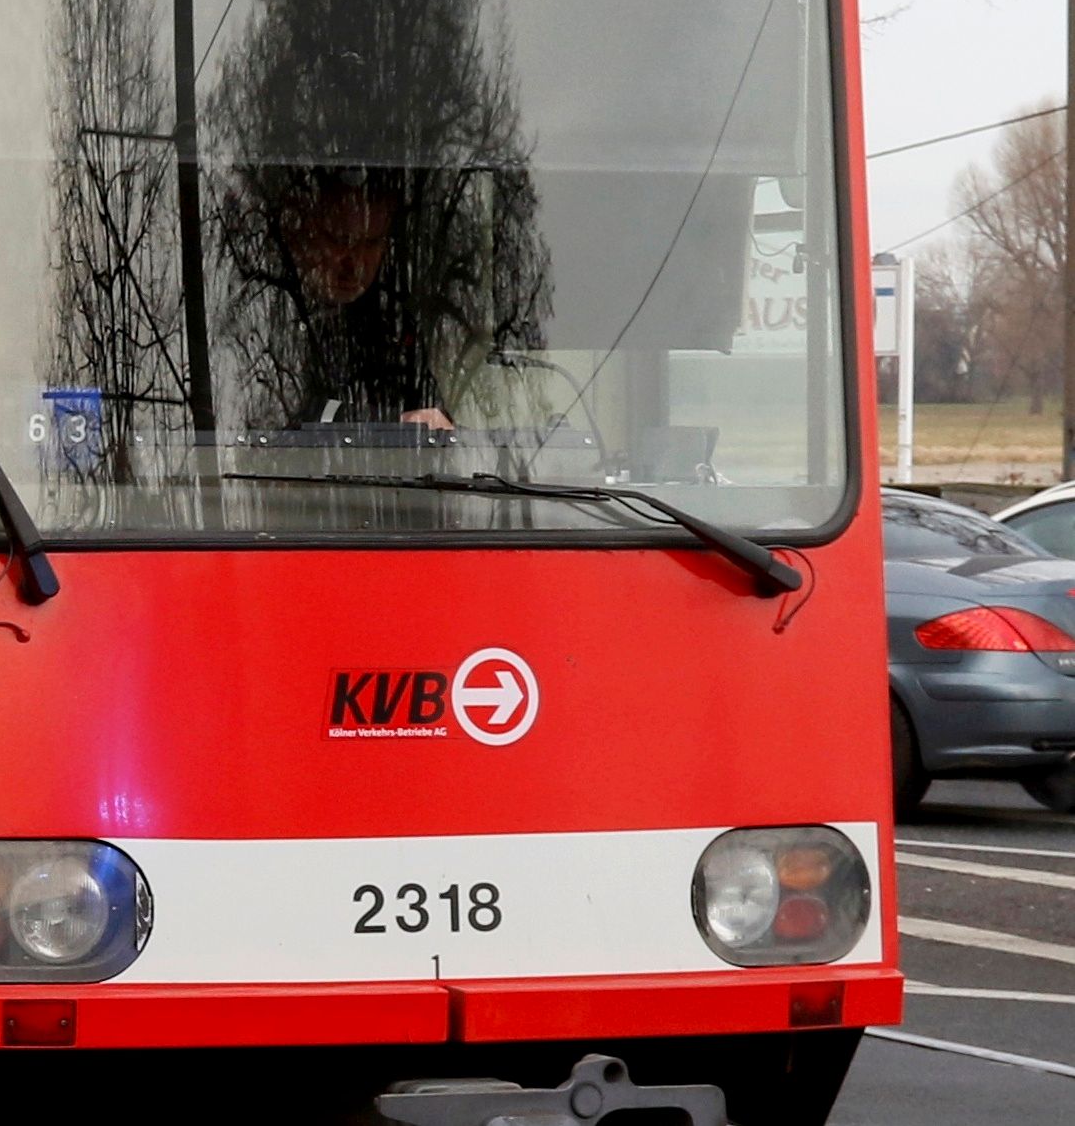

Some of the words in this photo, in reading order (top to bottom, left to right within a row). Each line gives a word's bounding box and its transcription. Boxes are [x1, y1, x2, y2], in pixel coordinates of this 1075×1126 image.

[29, 414, 46, 442] 6
[70, 415, 86, 442] 3
[329, 671, 448, 725] KVB
[328, 727, 357, 737] Kölner
[357, 727, 433, 737] Verkehrs-Betriebe
[433, 727, 447, 736] AG
[353, 882, 502, 934] 2318
